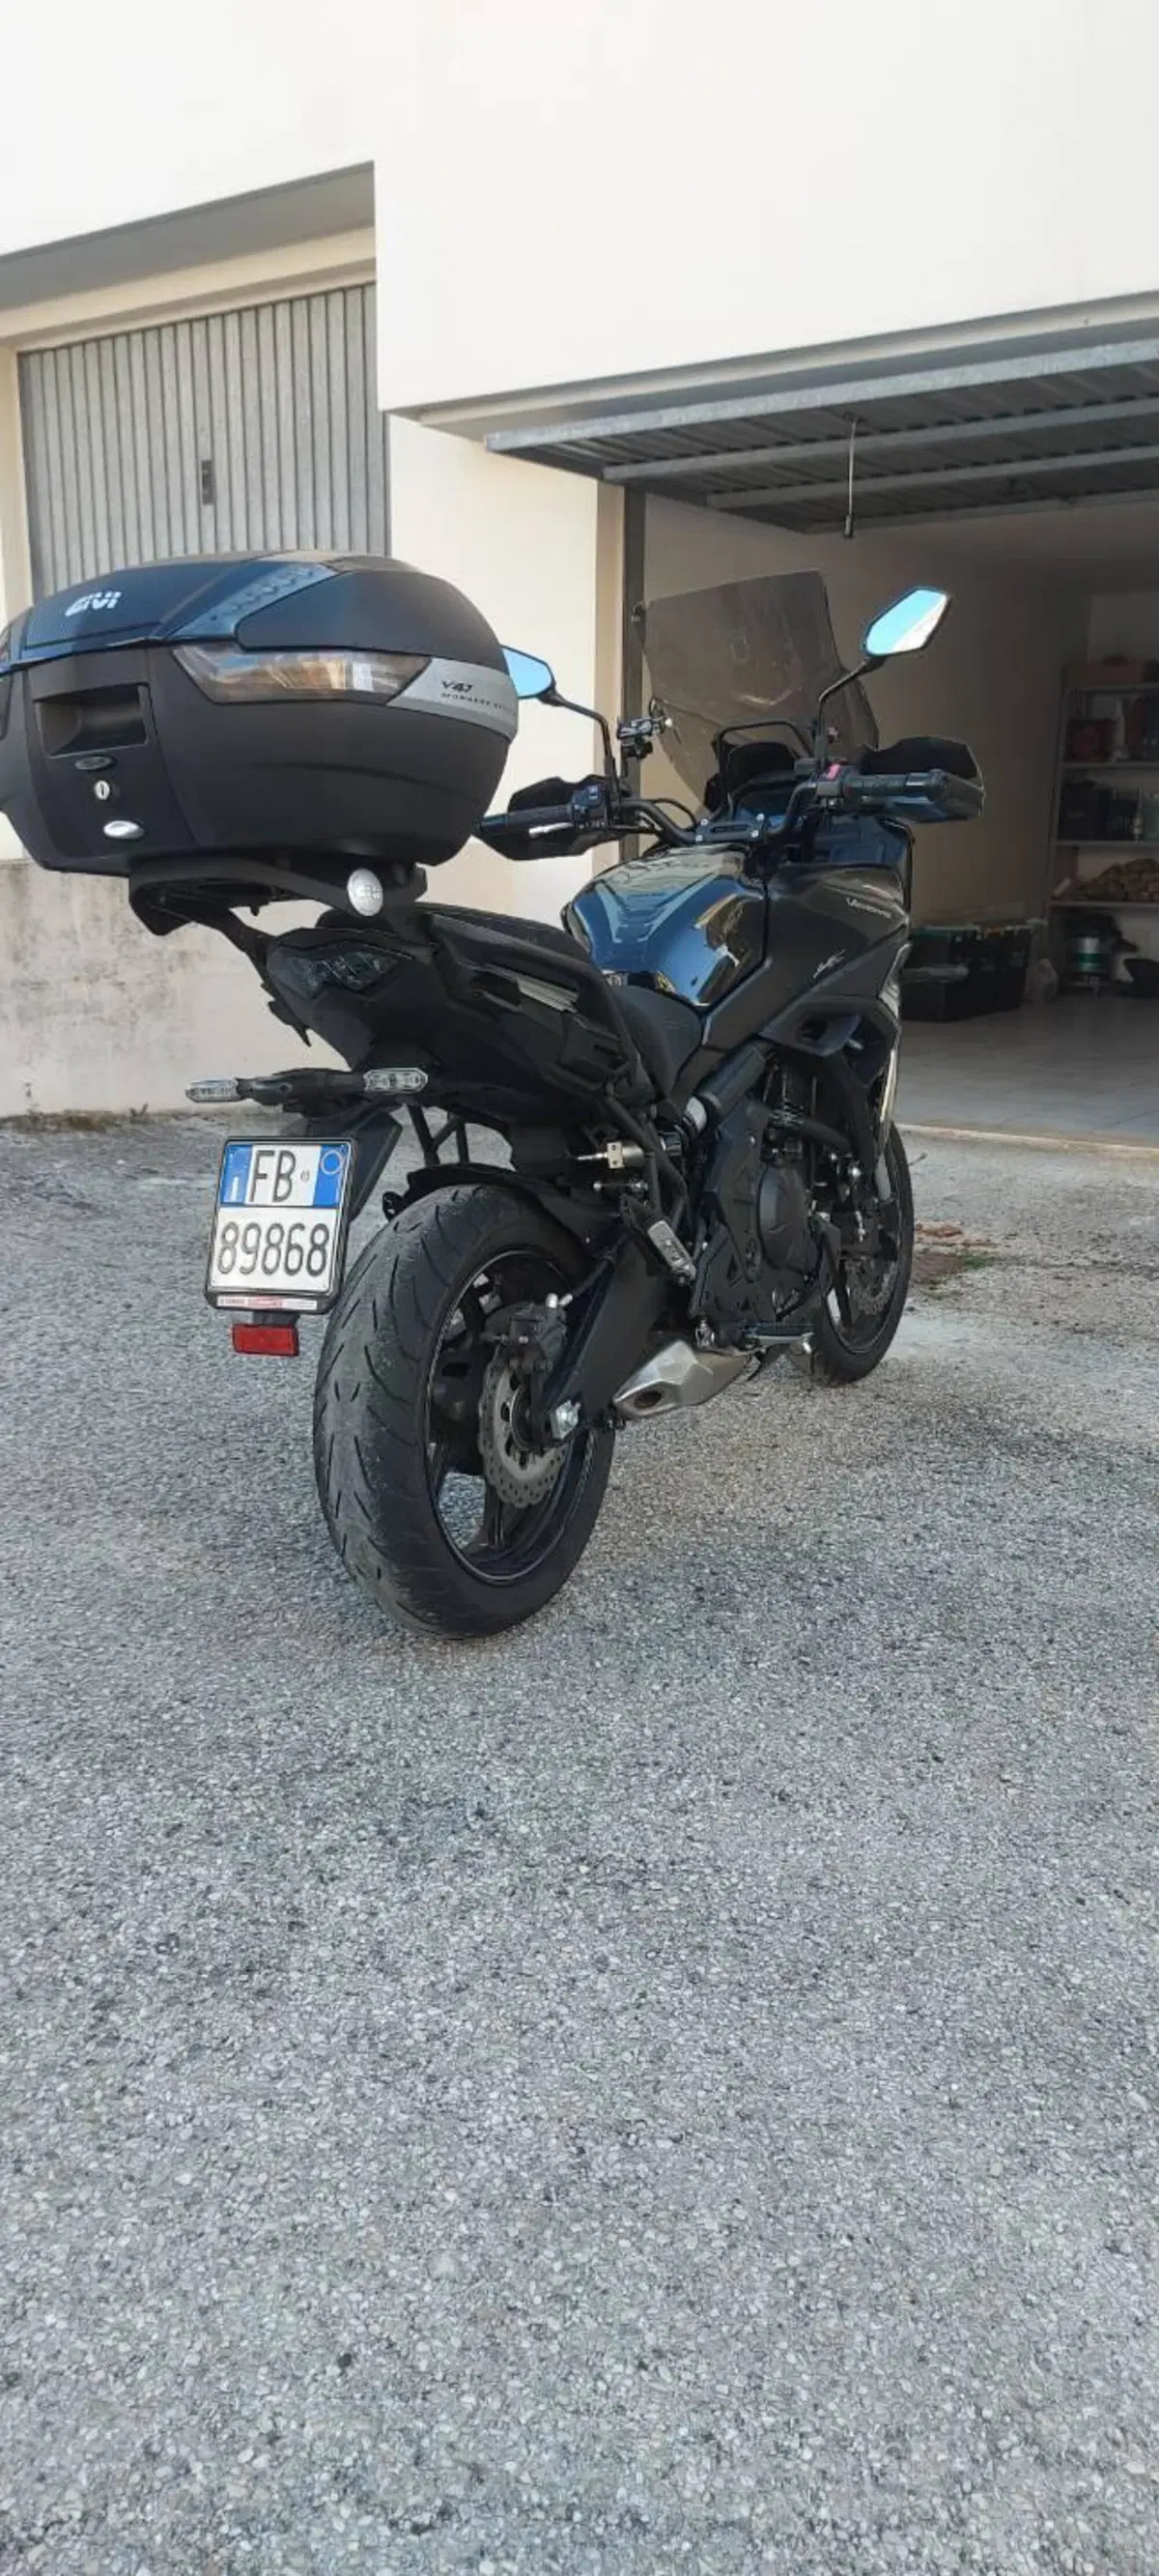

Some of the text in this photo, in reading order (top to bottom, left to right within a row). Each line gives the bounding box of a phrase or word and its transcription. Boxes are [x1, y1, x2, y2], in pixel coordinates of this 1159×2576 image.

[65, 591, 122, 616] GIVI
[441, 680, 473, 693] V47
[249, 1150, 296, 1203] FB
[217, 1221, 330, 1276] 89868
